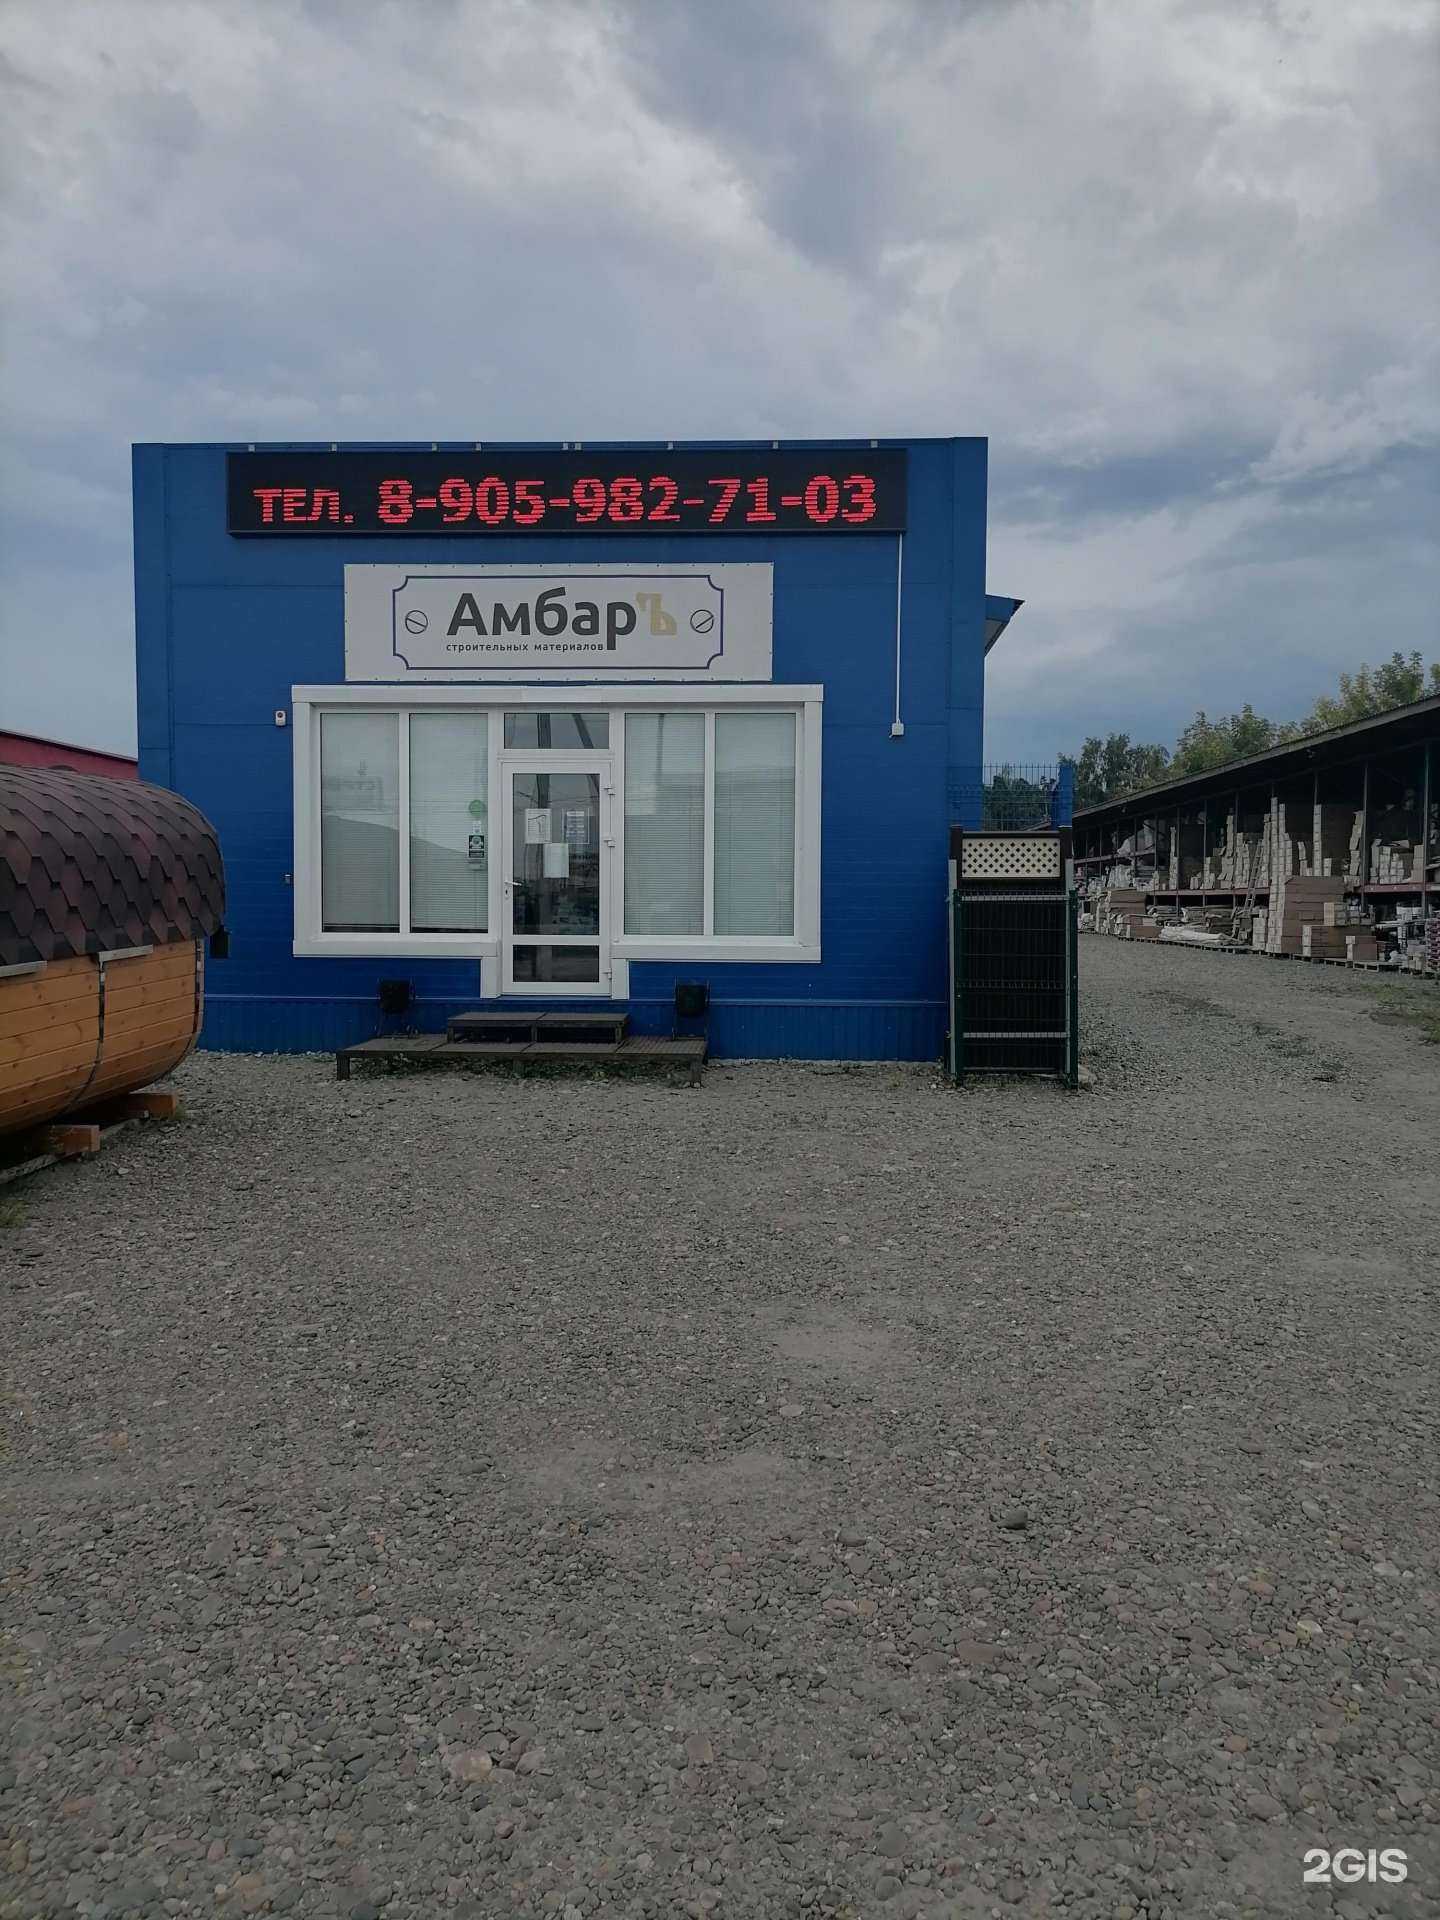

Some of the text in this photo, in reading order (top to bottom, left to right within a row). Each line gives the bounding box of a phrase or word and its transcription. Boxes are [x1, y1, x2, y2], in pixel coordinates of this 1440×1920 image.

[376, 476, 878, 524] 8-905-982-71-03
[446, 643, 604, 653] строительных материалов
